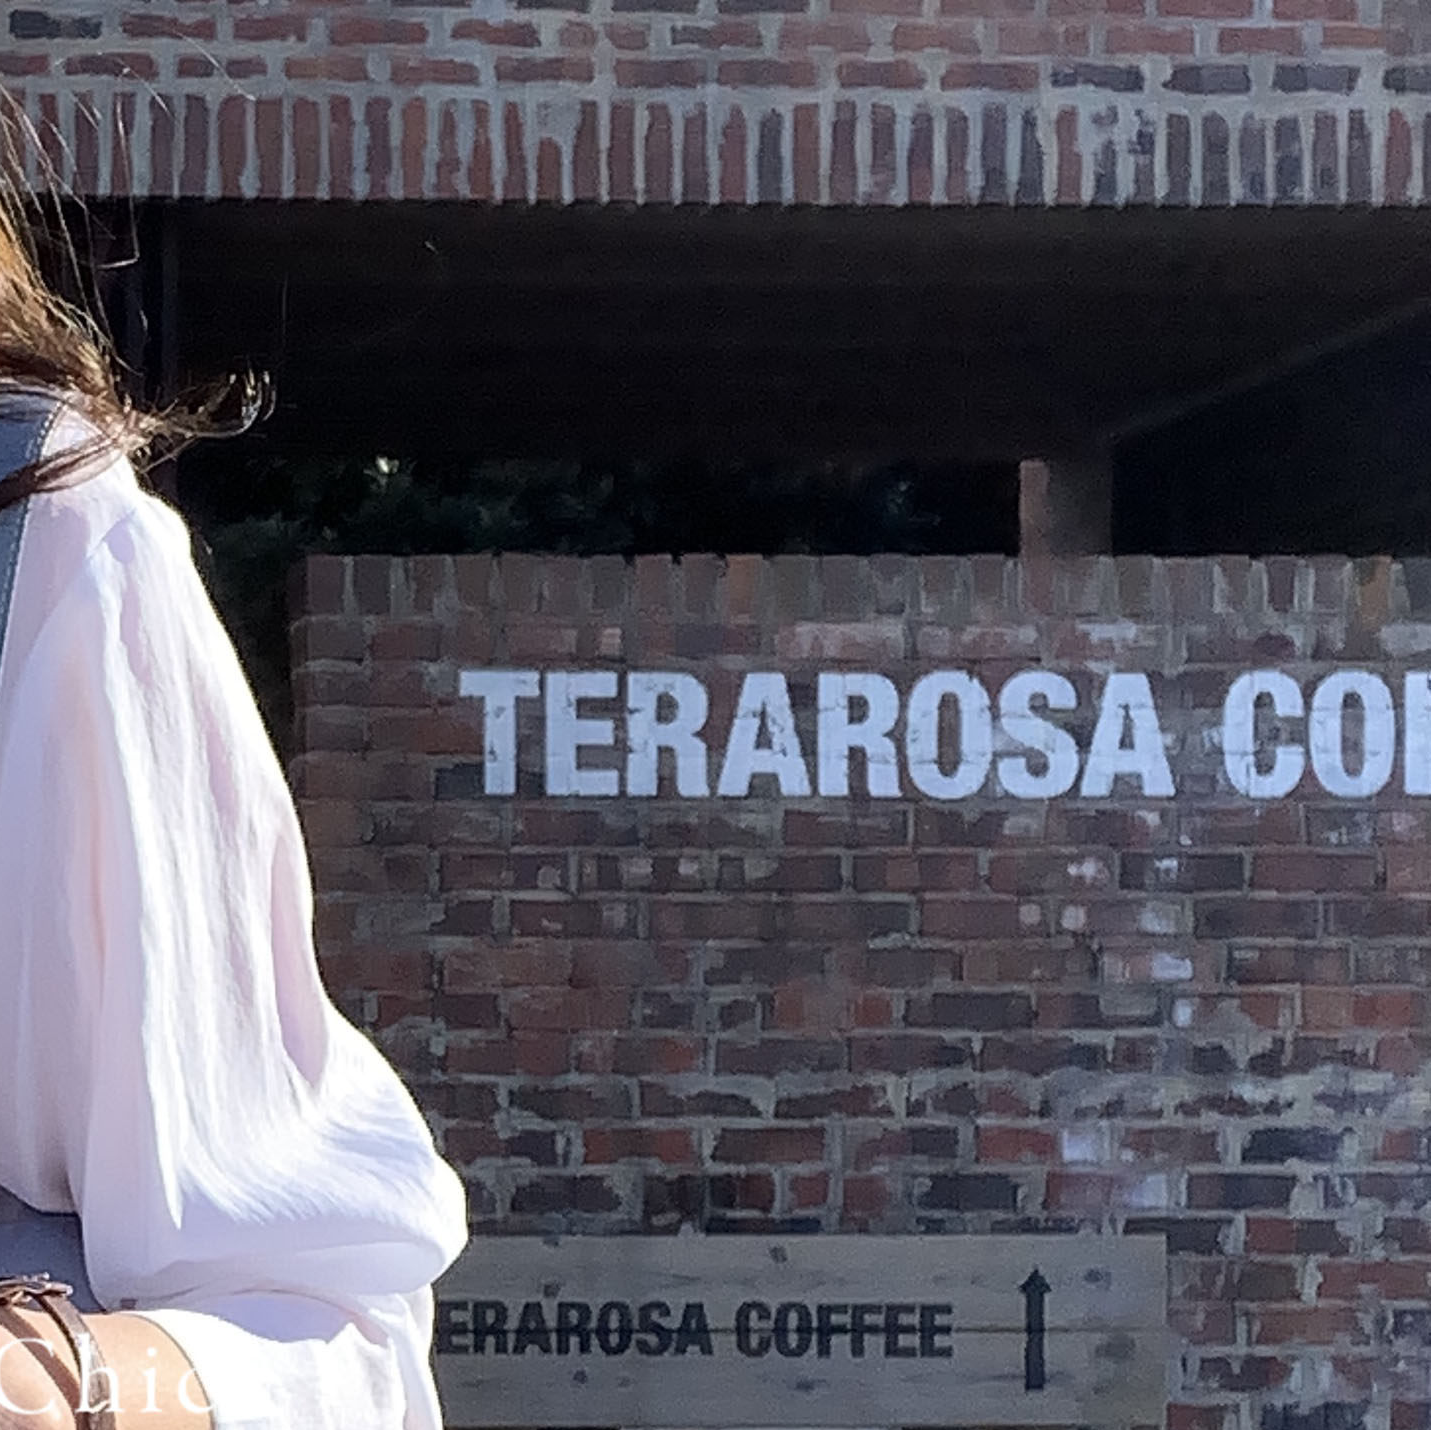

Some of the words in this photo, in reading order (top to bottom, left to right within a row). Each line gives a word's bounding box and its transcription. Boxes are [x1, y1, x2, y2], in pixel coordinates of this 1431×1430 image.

[458, 669, 1176, 799] TERAROSA
[436, 1300, 714, 1356] ERAROSA
[735, 1301, 953, 1358] COFFEE
